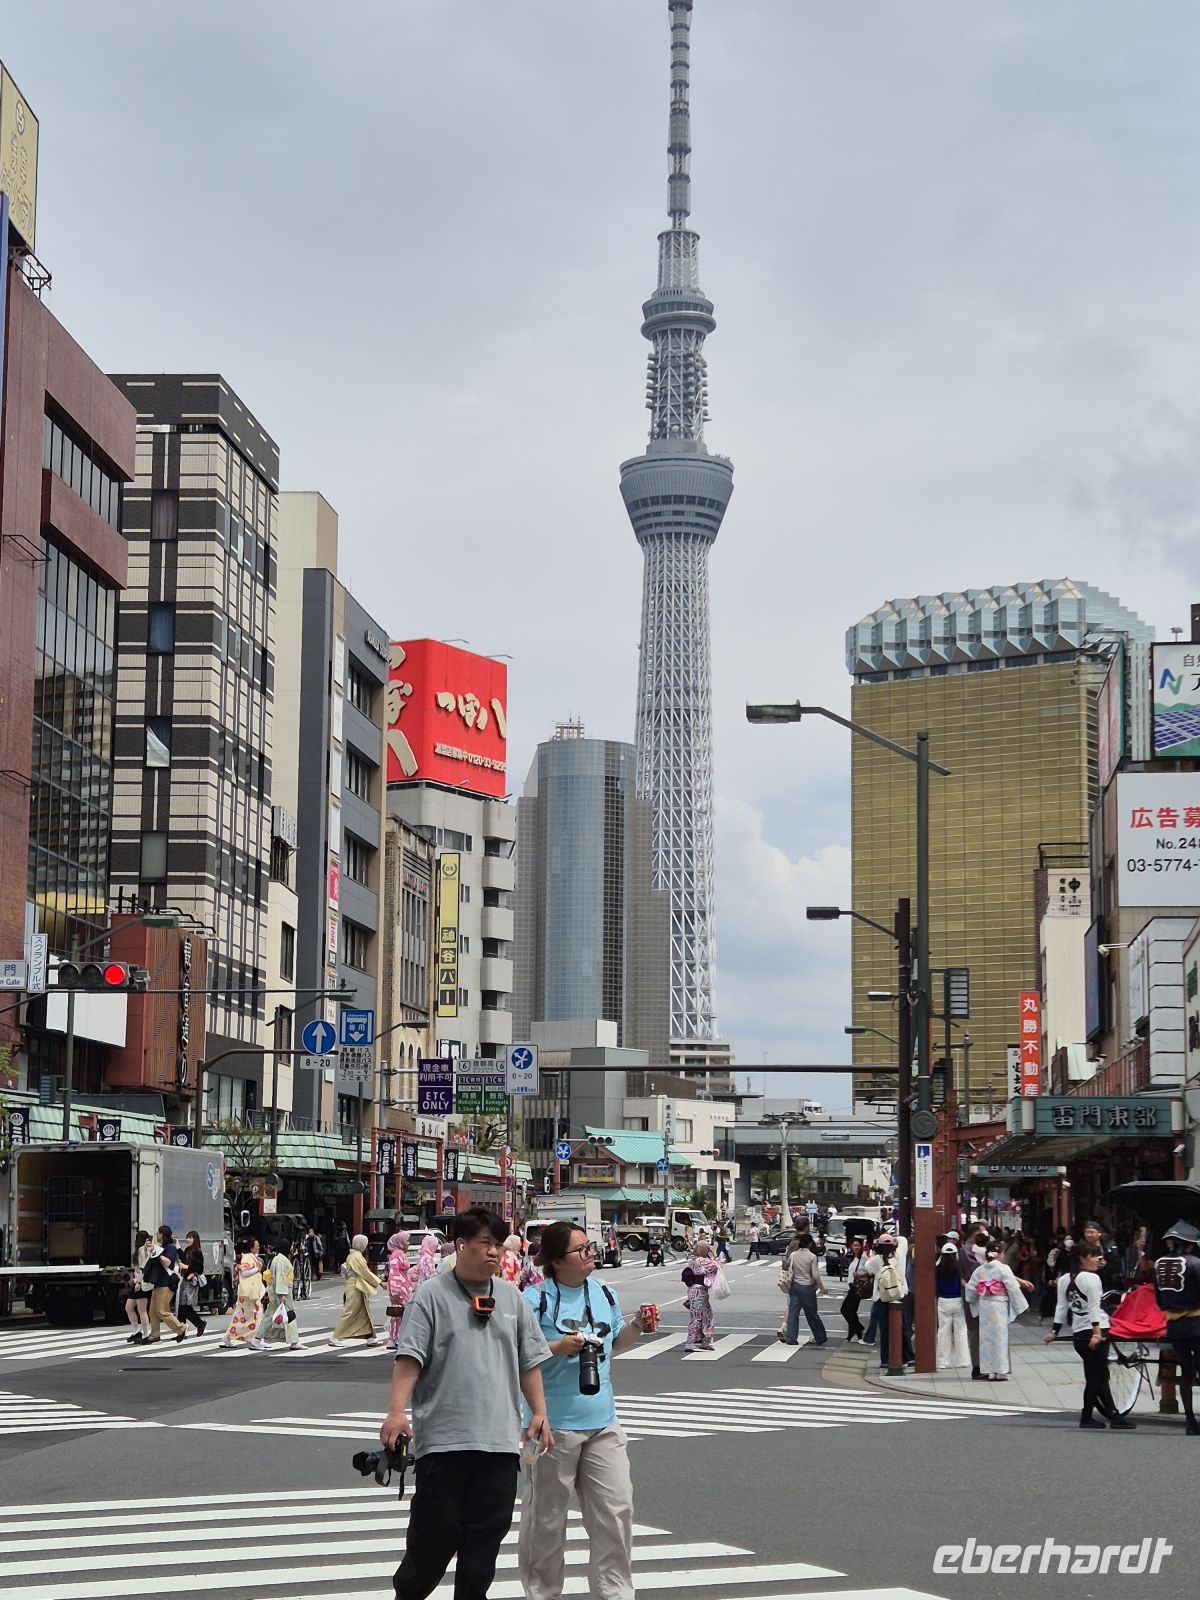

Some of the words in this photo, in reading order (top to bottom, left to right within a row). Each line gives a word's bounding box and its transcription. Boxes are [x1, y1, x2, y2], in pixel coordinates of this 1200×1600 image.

[1130, 807, 1200, 828] 広告募
[1156, 837, 1200, 850] No.24
[1127, 858, 1200, 873] 03-5774-
[32, 936, 43, 990] スクランブル式
[440, 928, 456, 1004] 神谷バー
[1022, 998, 1039, 1097] 丸勝不動産
[420, 1073, 452, 1081] 利用不可
[426, 1091, 446, 1100] ETC
[422, 1101, 449, 1110] ONLY
[1053, 1105, 1156, 1127] 雷門東部
